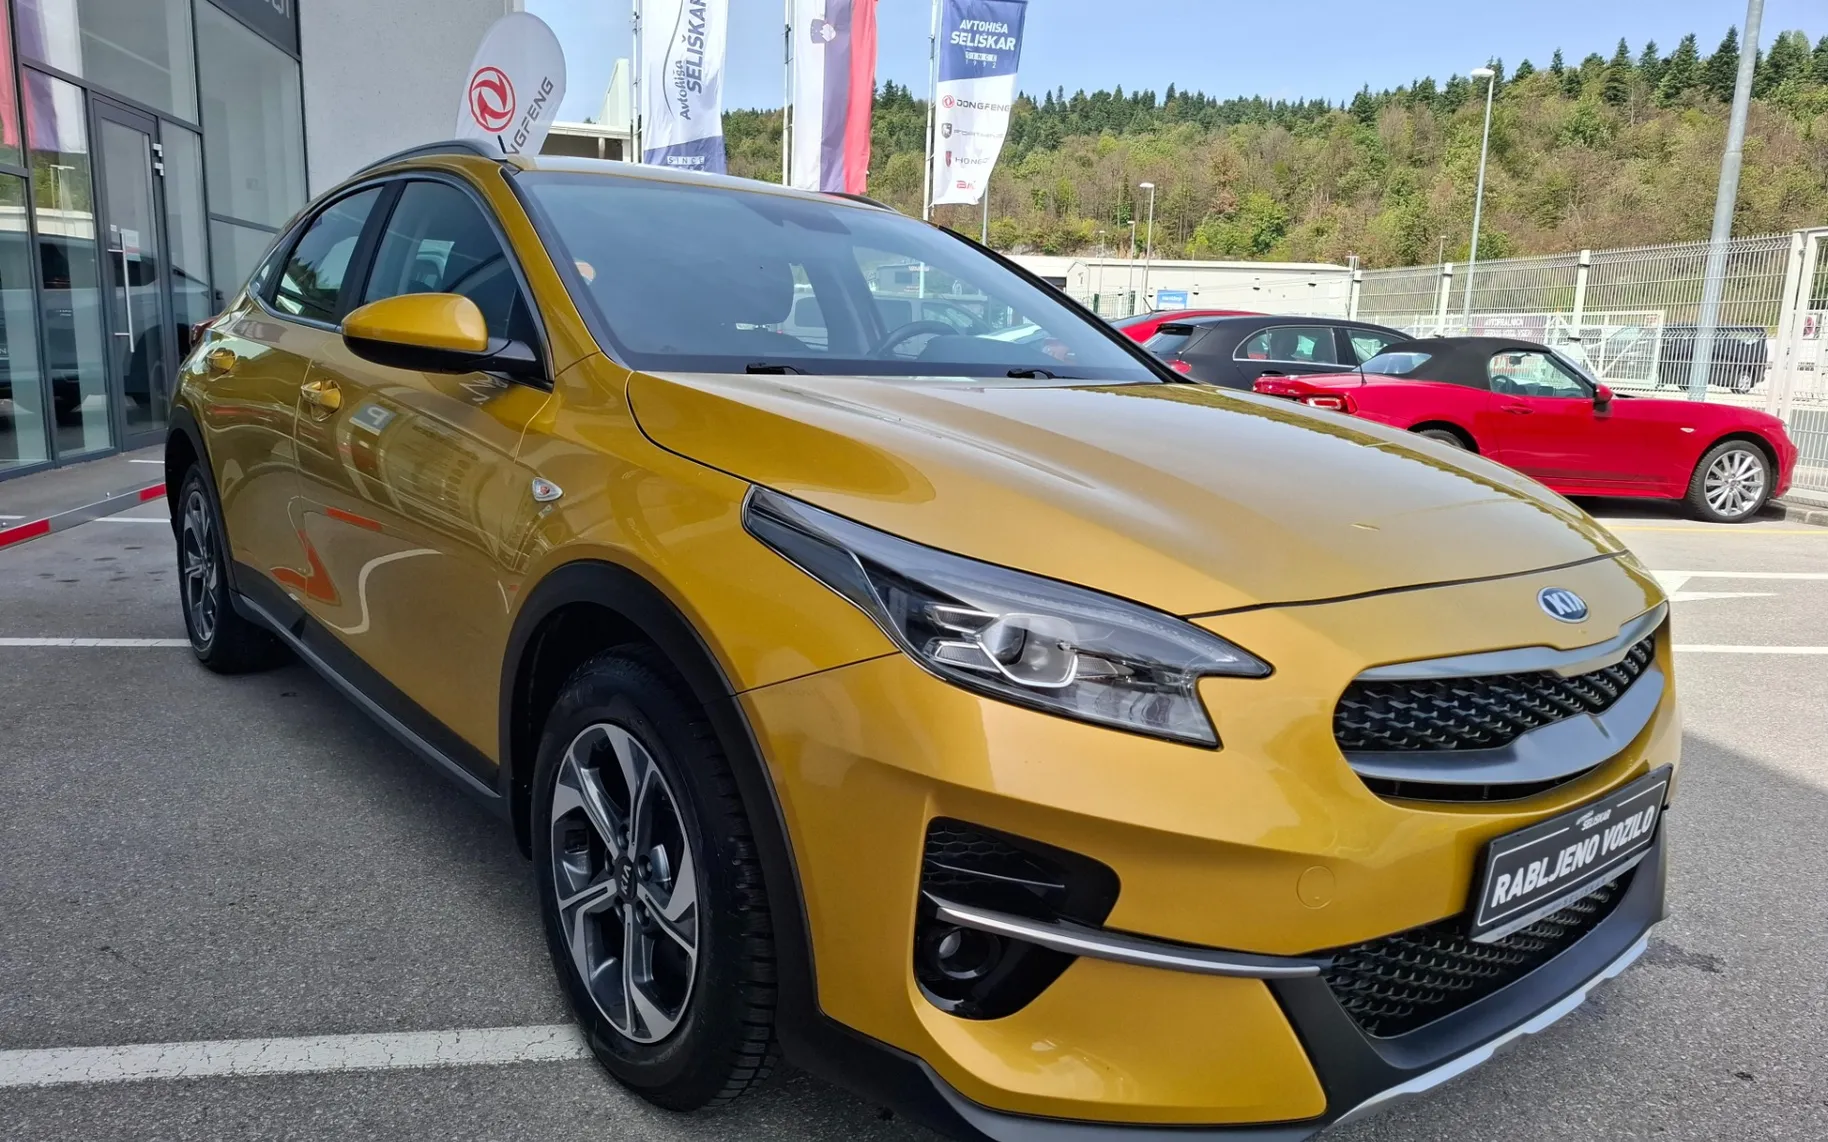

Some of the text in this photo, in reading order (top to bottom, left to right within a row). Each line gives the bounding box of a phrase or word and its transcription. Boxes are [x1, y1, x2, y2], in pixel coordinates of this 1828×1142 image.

[959, 19, 1008, 34] AVTOHIŠA
[950, 31, 1016, 51] SELIŠKAR
[505, 76, 554, 154] NGFENG
[956, 99, 1010, 112] DONGFENG
[669, 156, 704, 165] SINCE
[1543, 589, 1582, 615] KIA
[1491, 834, 1600, 908] RABLJENO
[1601, 804, 1655, 856] VOZILO
[620, 865, 631, 895] KIA
